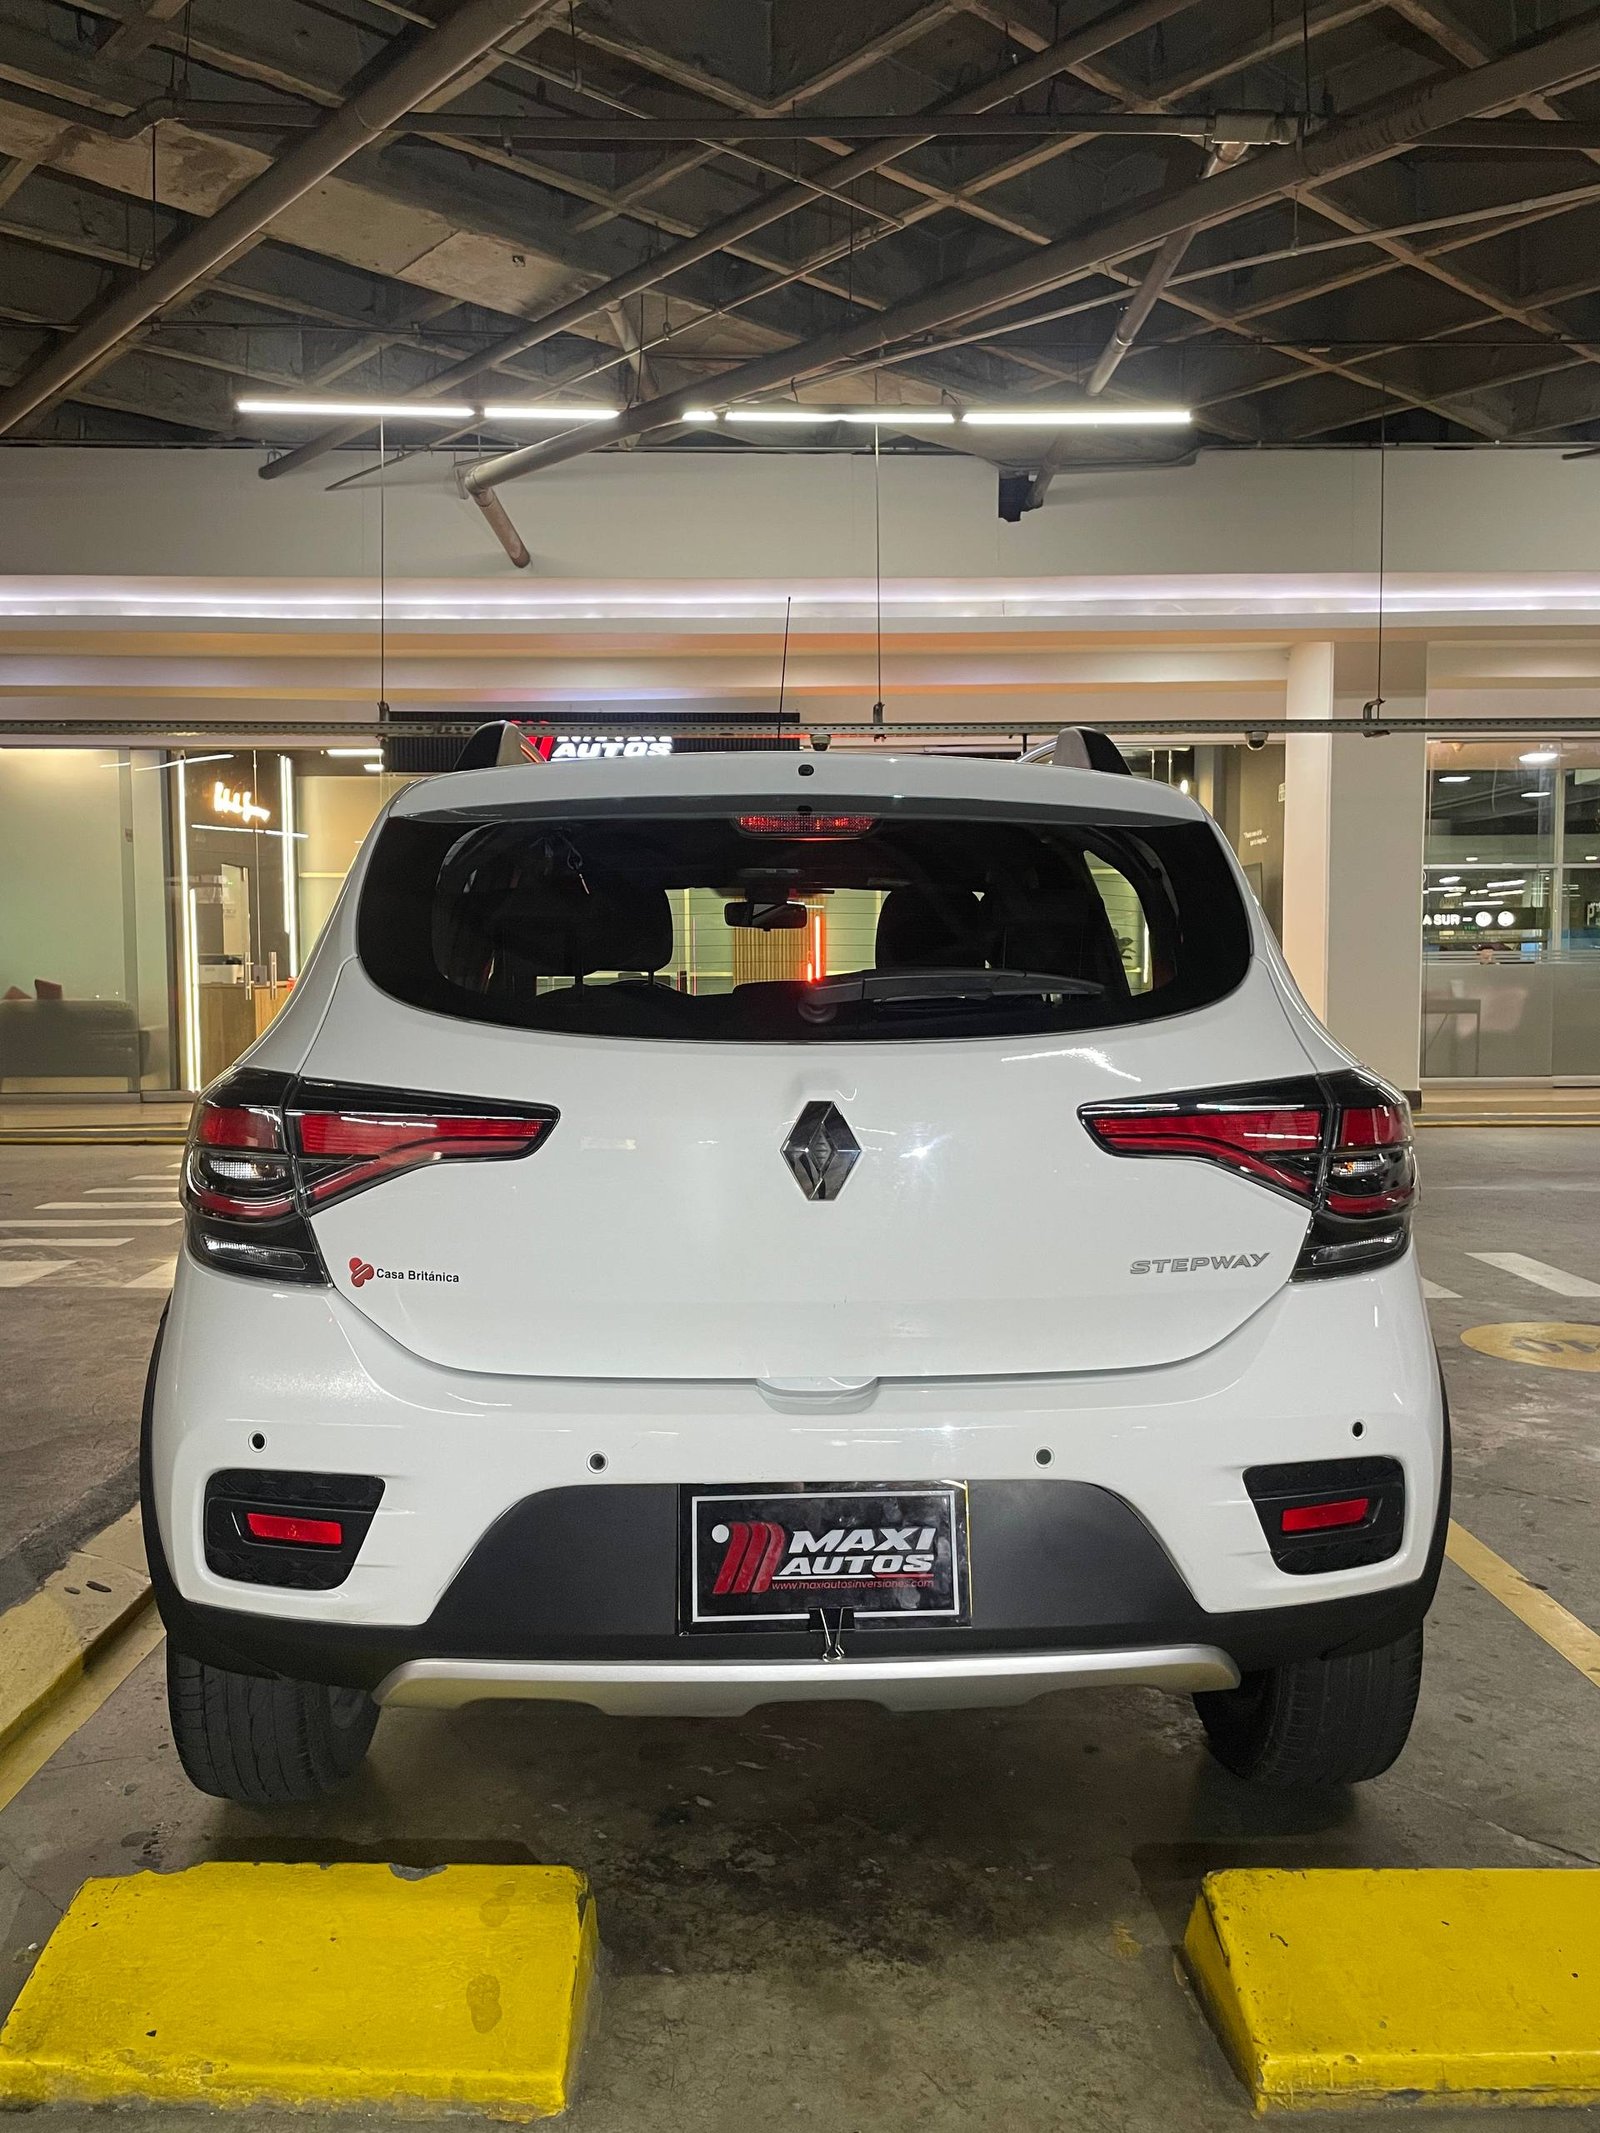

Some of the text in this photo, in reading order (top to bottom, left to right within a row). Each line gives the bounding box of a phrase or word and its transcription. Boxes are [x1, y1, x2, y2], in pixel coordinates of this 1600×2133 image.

[551, 742, 673, 757] AUTOS
[1433, 914, 1461, 926] SUR
[1130, 1252, 1270, 1275] STEPWAY
[376, 1268, 460, 1283] Casa Británica
[788, 1527, 937, 1554] MAXI
[779, 1554, 935, 1576] AUTOS
